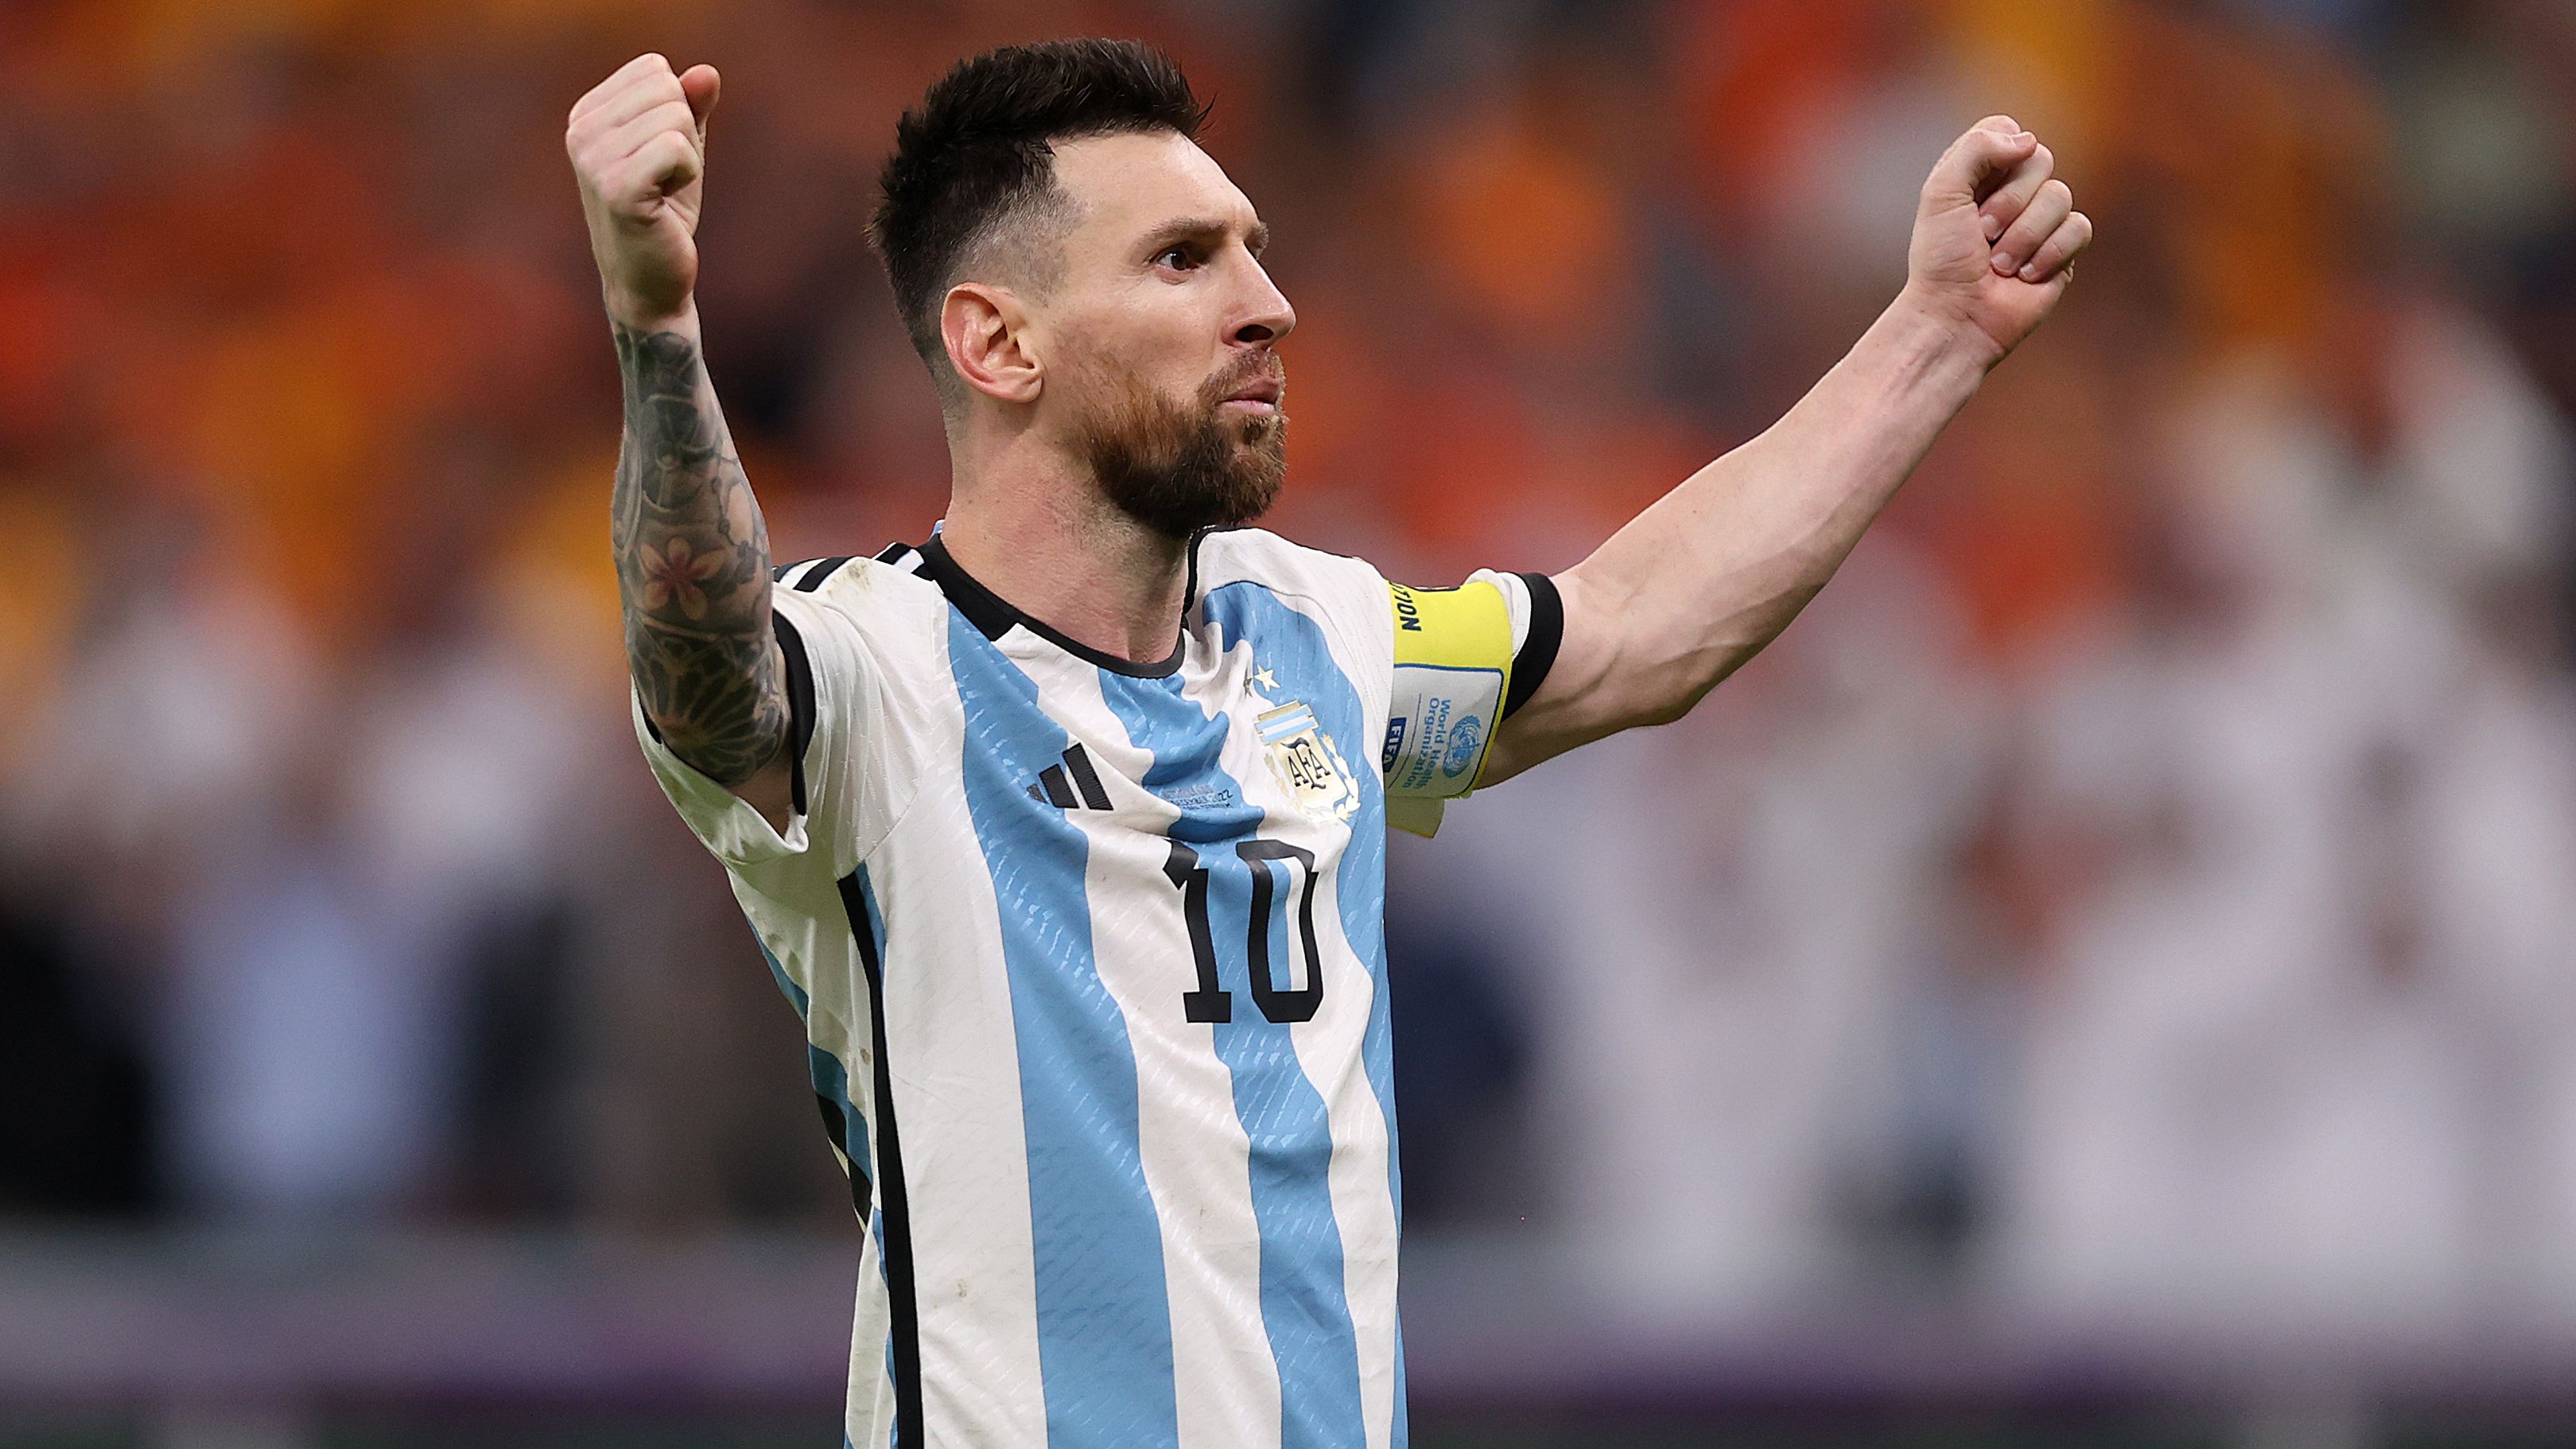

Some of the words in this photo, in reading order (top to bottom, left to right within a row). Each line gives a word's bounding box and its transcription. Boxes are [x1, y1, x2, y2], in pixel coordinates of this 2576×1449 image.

[1383, 725, 1402, 764] FIFA
[1402, 697, 1440, 788] Organization
[1435, 699, 1451, 744] World
[1280, 736, 1331, 790] AFA
[1414, 750, 1441, 789] Health
[1162, 838, 1324, 1024] 10
